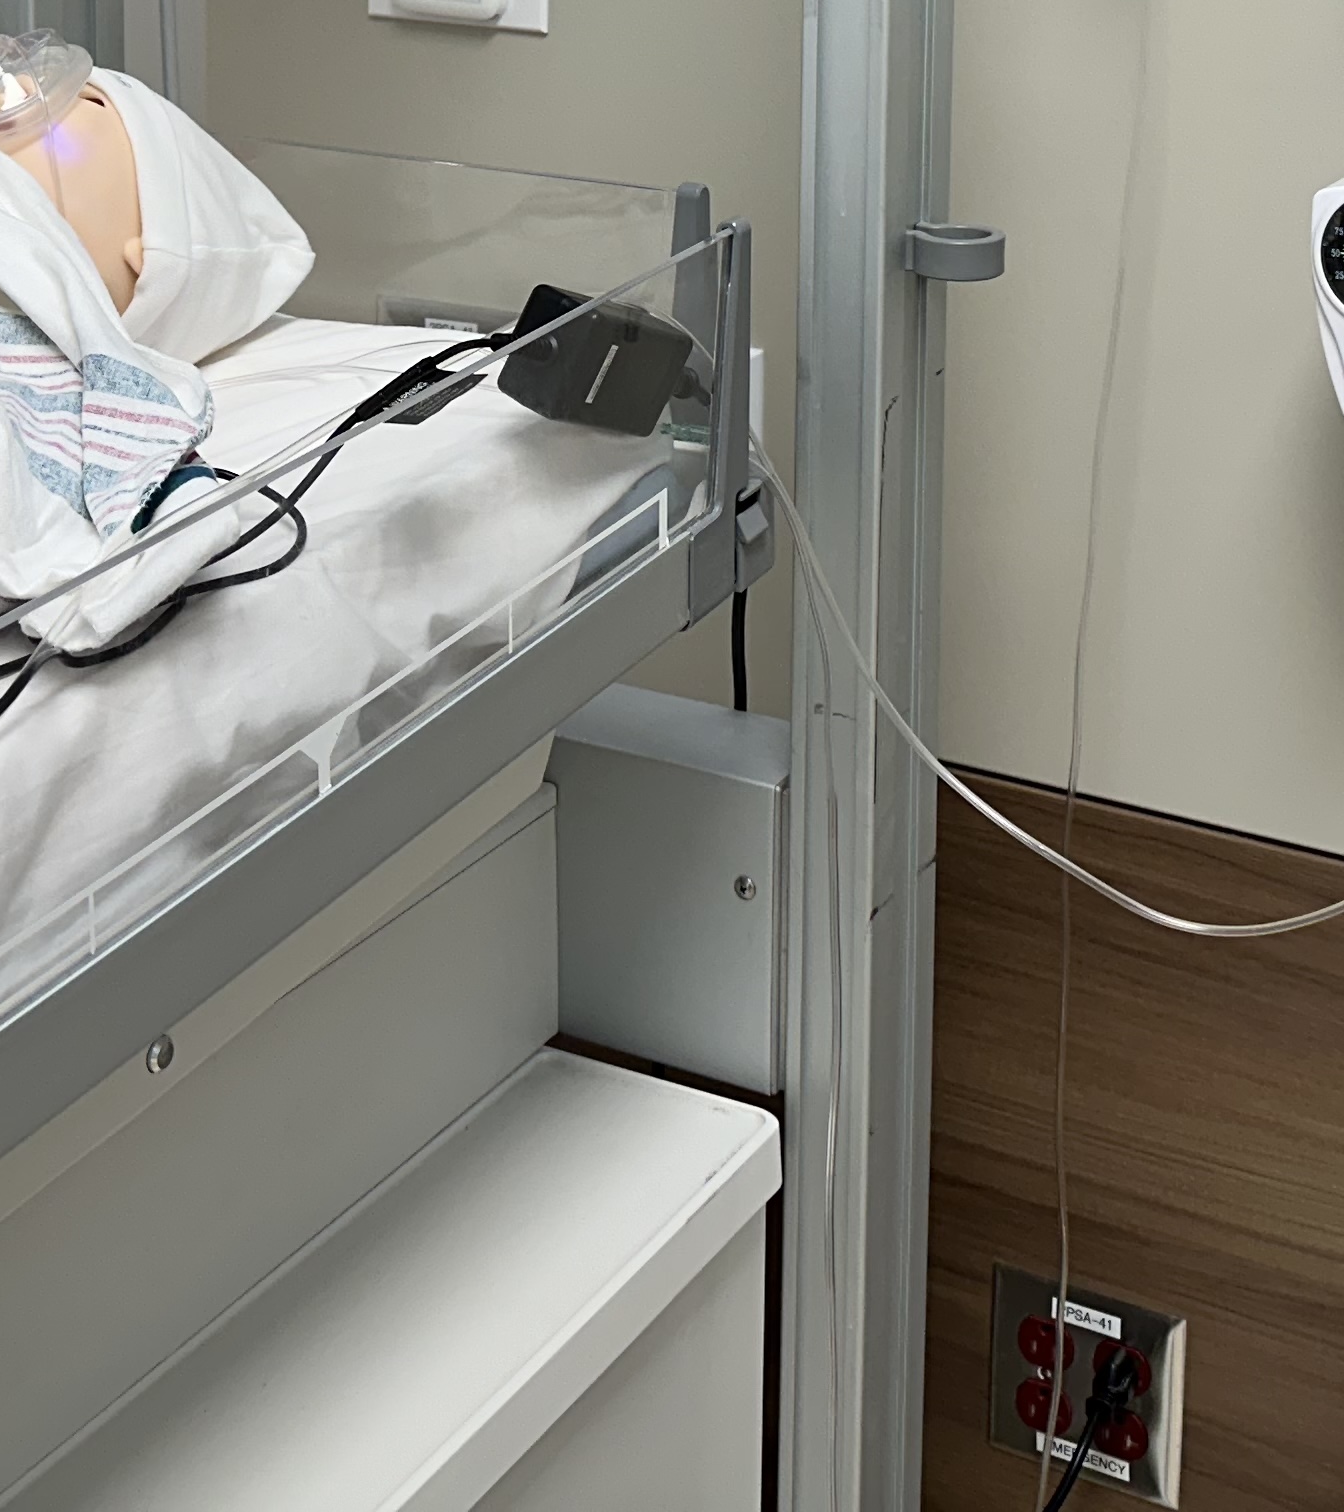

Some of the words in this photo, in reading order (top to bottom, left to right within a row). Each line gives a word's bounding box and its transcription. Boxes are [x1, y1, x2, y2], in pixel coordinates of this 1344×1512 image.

[1334, 226, 1344, 236] 75
[1330, 248, 1341, 258] 50
[1335, 271, 1344, 280] 25
[1063, 1304, 1113, 1332] PSA-41
